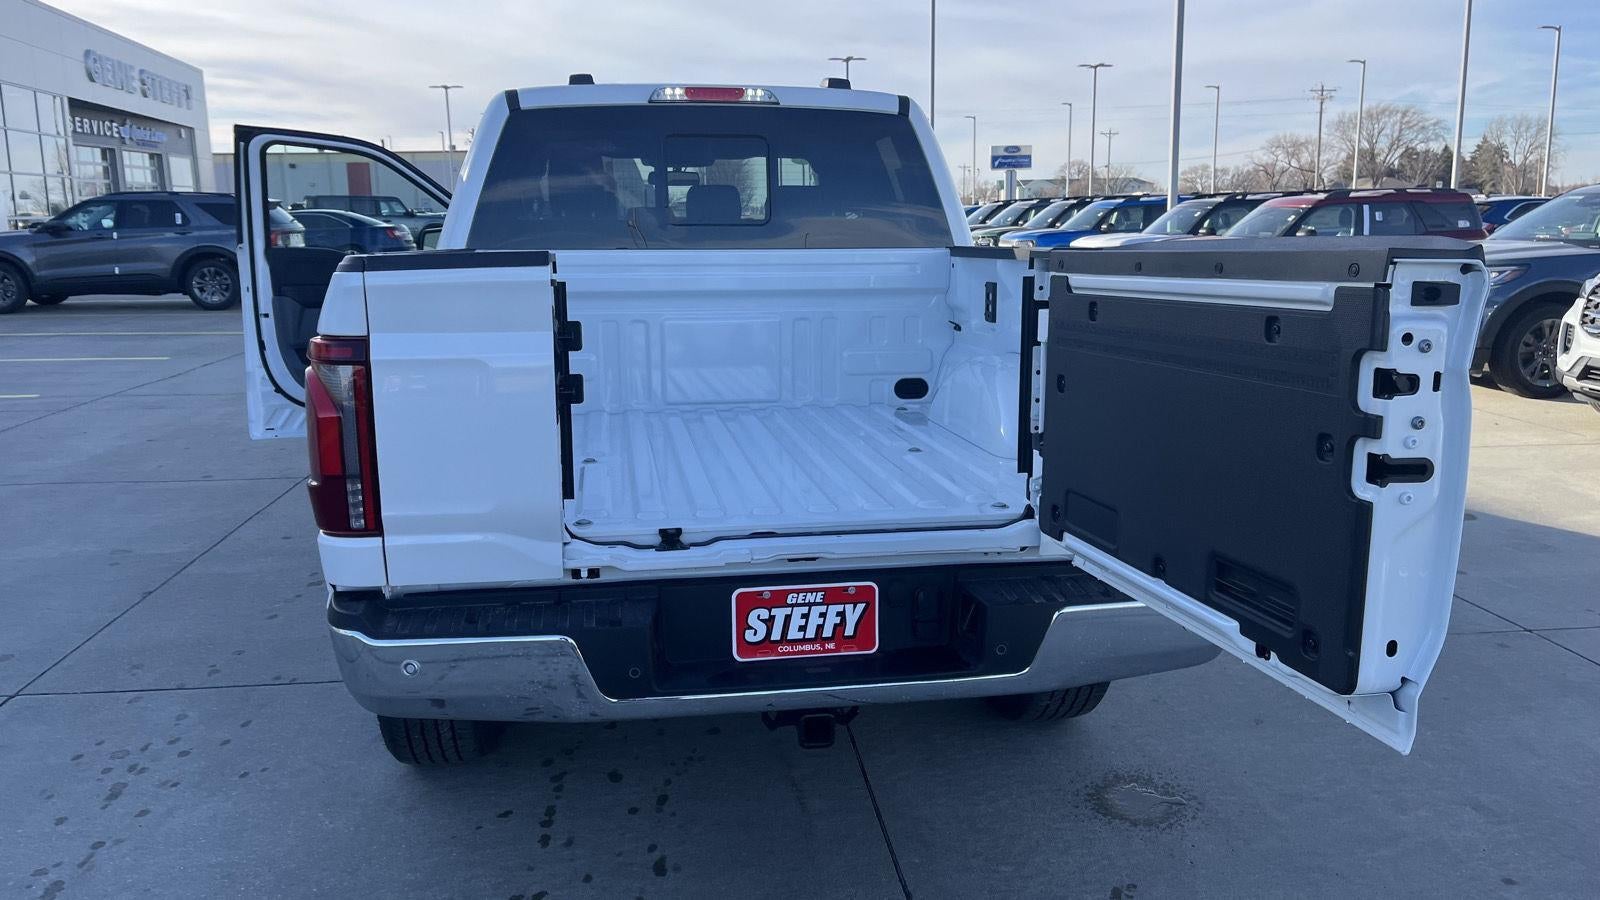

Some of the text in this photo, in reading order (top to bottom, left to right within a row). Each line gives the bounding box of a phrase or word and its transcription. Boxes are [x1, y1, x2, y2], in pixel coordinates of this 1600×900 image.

[84, 49, 193, 110] GENE STEFFY
[68, 115, 120, 138] SERVICE
[786, 592, 825, 604] GENE
[744, 603, 867, 643] STEFFY
[778, 643, 823, 653] COLUMBUS,
